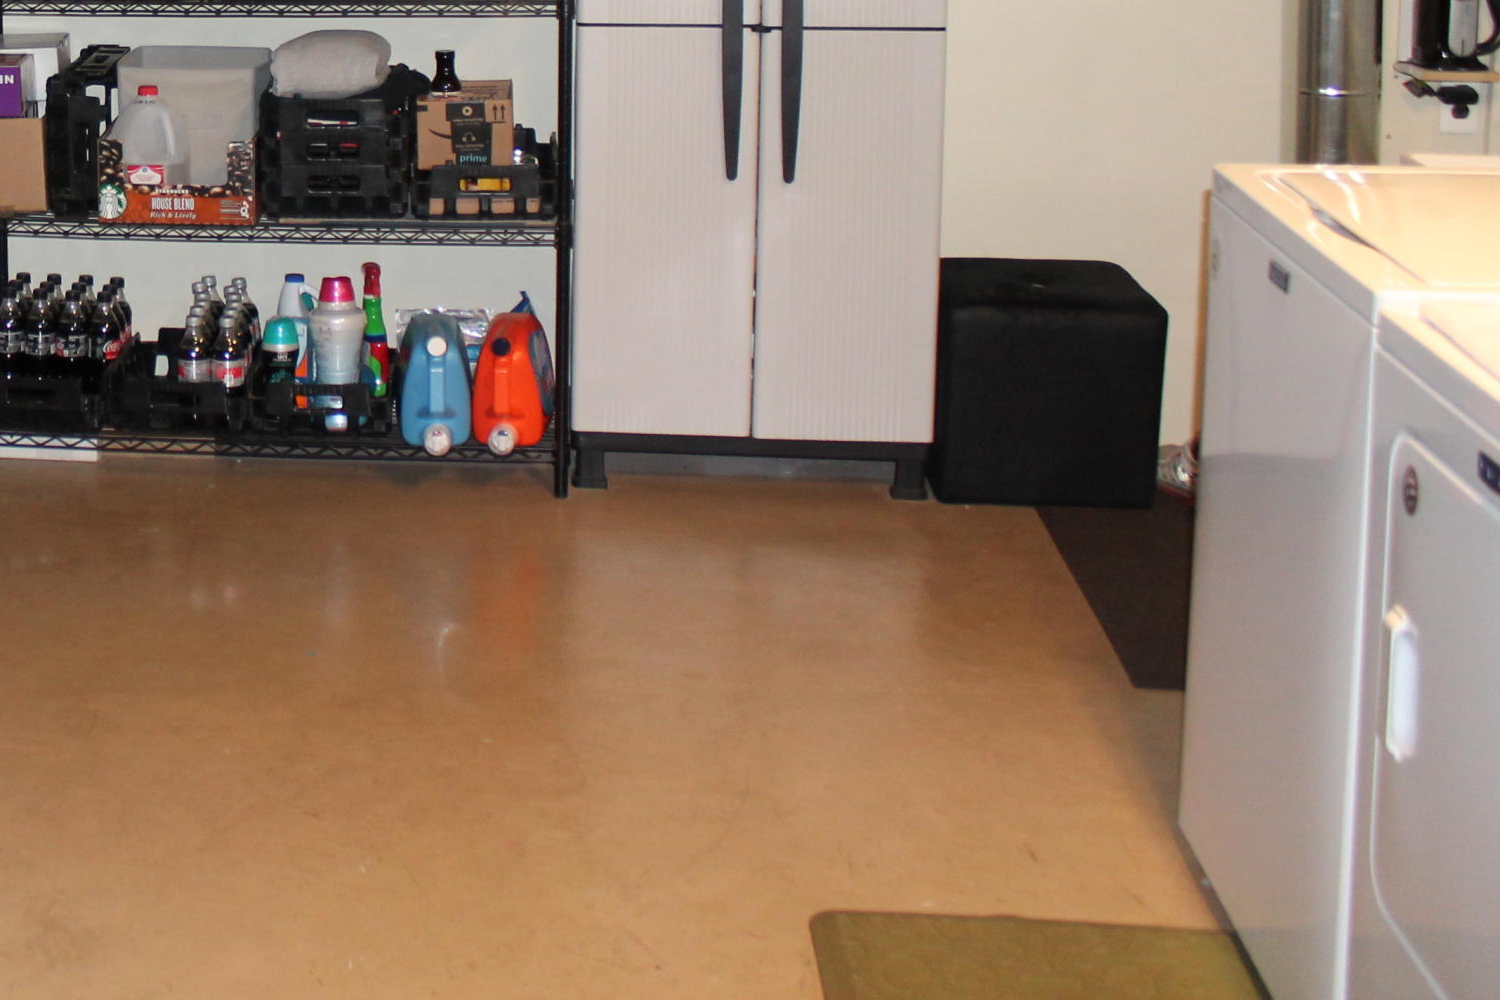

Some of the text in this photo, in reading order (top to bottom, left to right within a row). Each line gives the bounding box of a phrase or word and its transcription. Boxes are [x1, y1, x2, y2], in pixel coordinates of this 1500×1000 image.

[460, 153, 488, 163] prime
[151, 197, 195, 211] HOUSE BLEND
[150, 211, 167, 219] Rich
[174, 211, 197, 220] Lively
